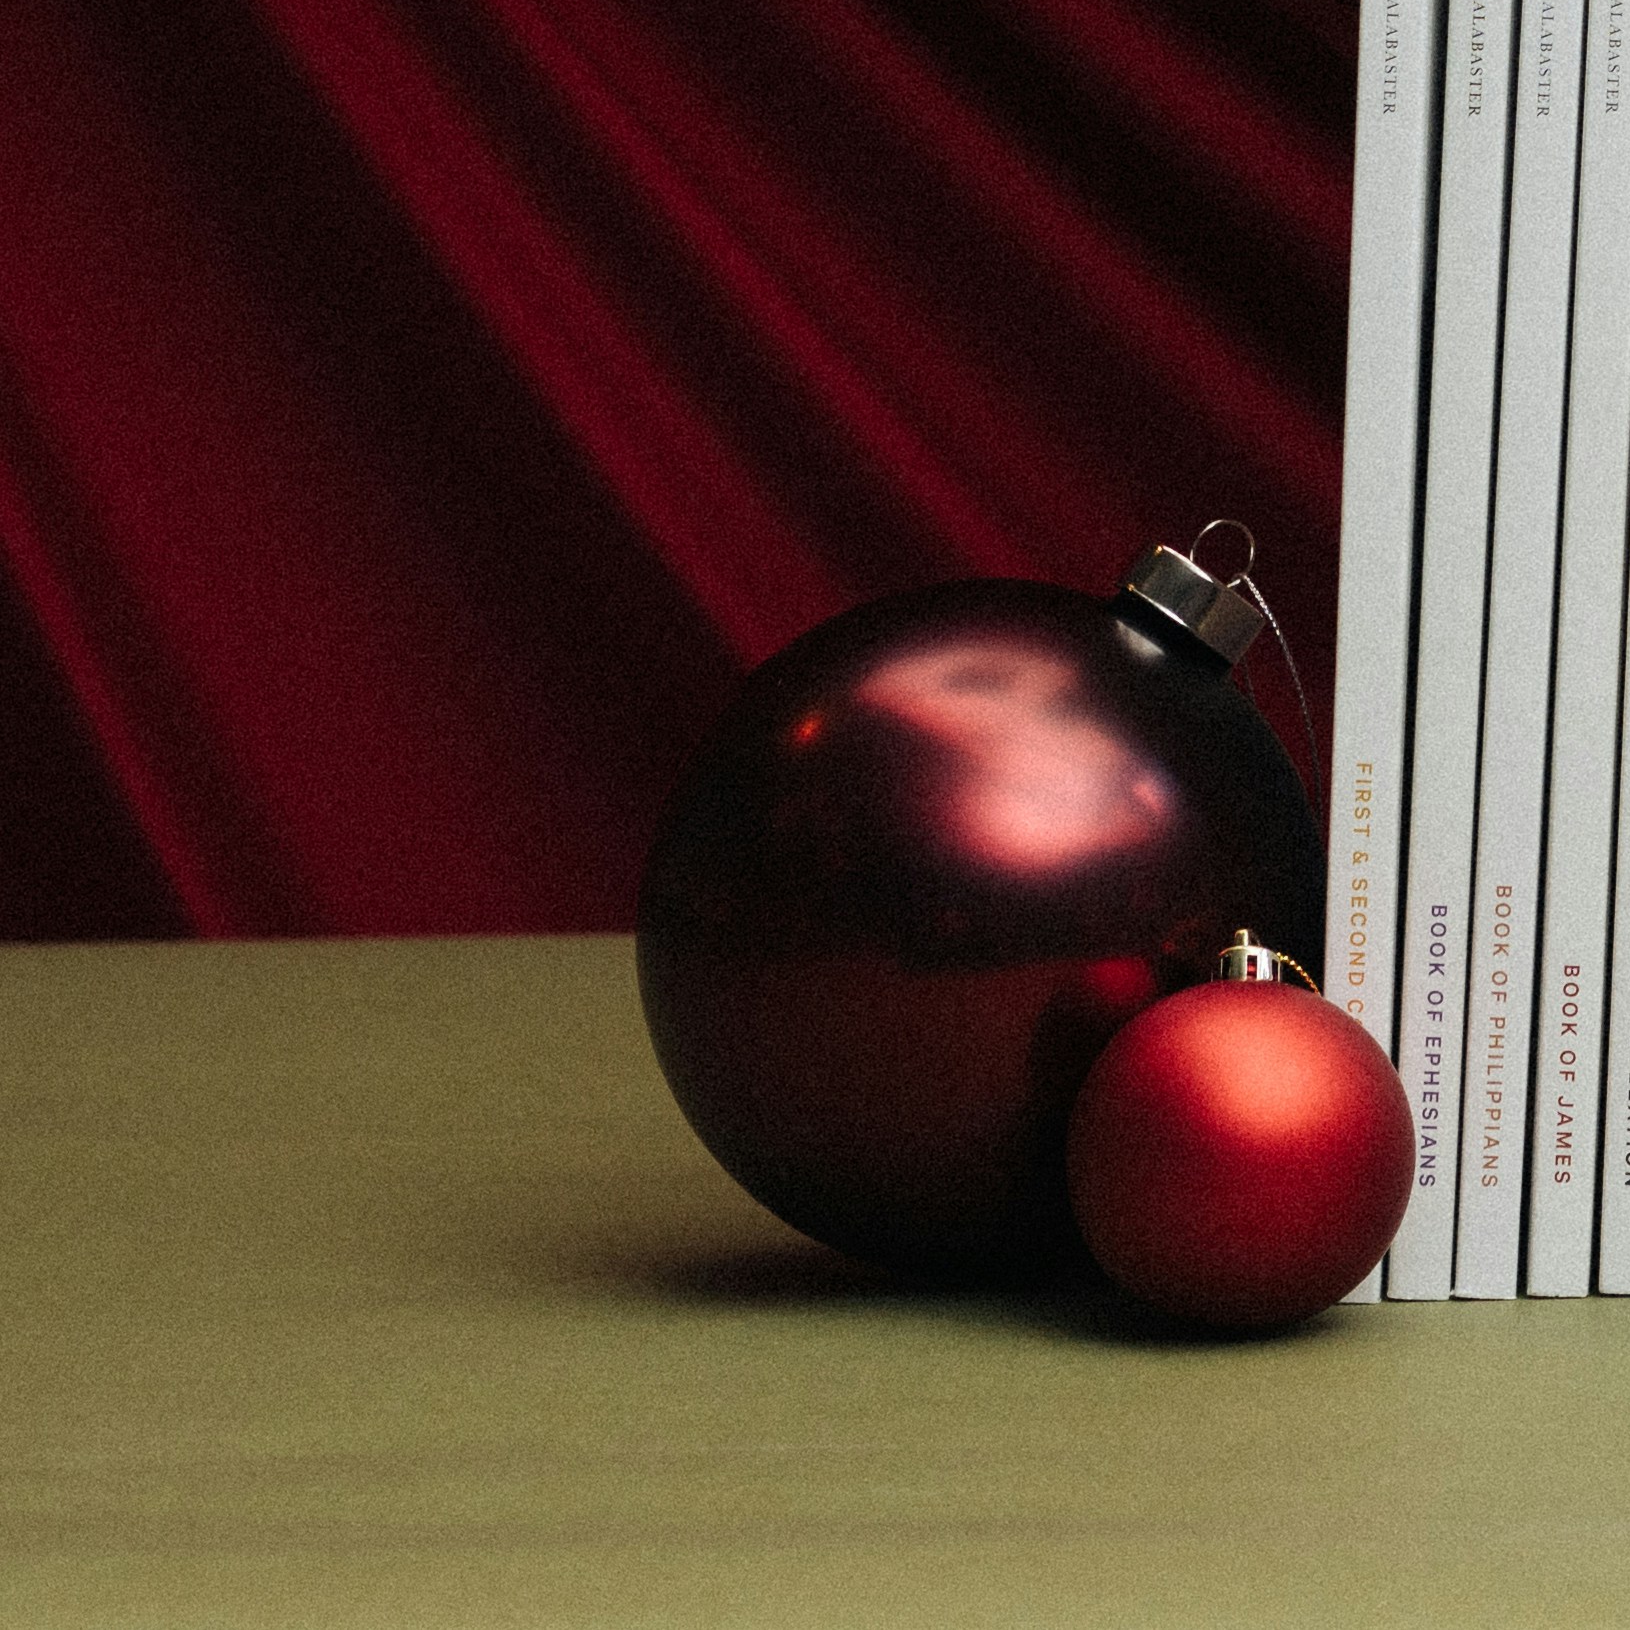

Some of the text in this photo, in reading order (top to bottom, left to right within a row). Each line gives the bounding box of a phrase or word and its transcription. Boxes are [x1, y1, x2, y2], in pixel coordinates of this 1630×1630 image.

[1467, 1, 1486, 117] ALABASTER
[1537, 1, 1554, 118] ALABASTER
[1351, 850, 1370, 866] &
[1353, 762, 1374, 838] FIRST
[1347, 877, 1369, 987] SECOND
[1419, 904, 1448, 1188] BOOK OF EPHESIANS
[1480, 885, 1513, 1188] BOOK OF PHILIPPIANS
[1553, 964, 1581, 1184] BOOK OF JAMES
